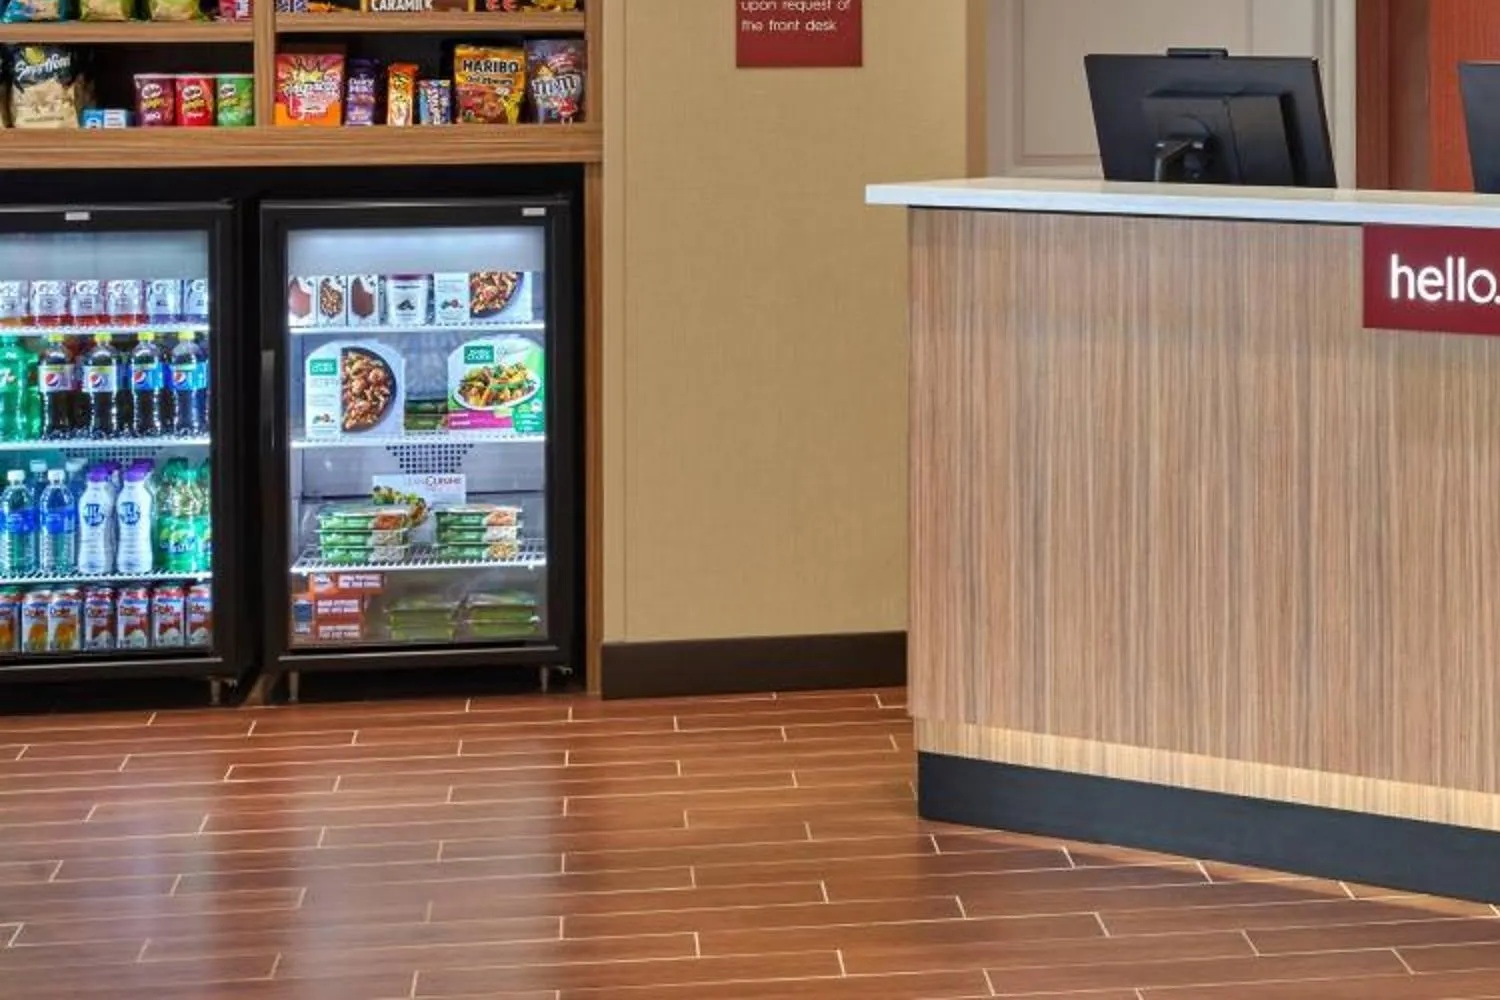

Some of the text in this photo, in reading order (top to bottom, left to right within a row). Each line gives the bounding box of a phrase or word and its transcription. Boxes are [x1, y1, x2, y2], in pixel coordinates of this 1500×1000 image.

[741, 0, 777, 13] upon
[741, 20, 837, 31] the front desk
[463, 59, 519, 73] HARIBO
